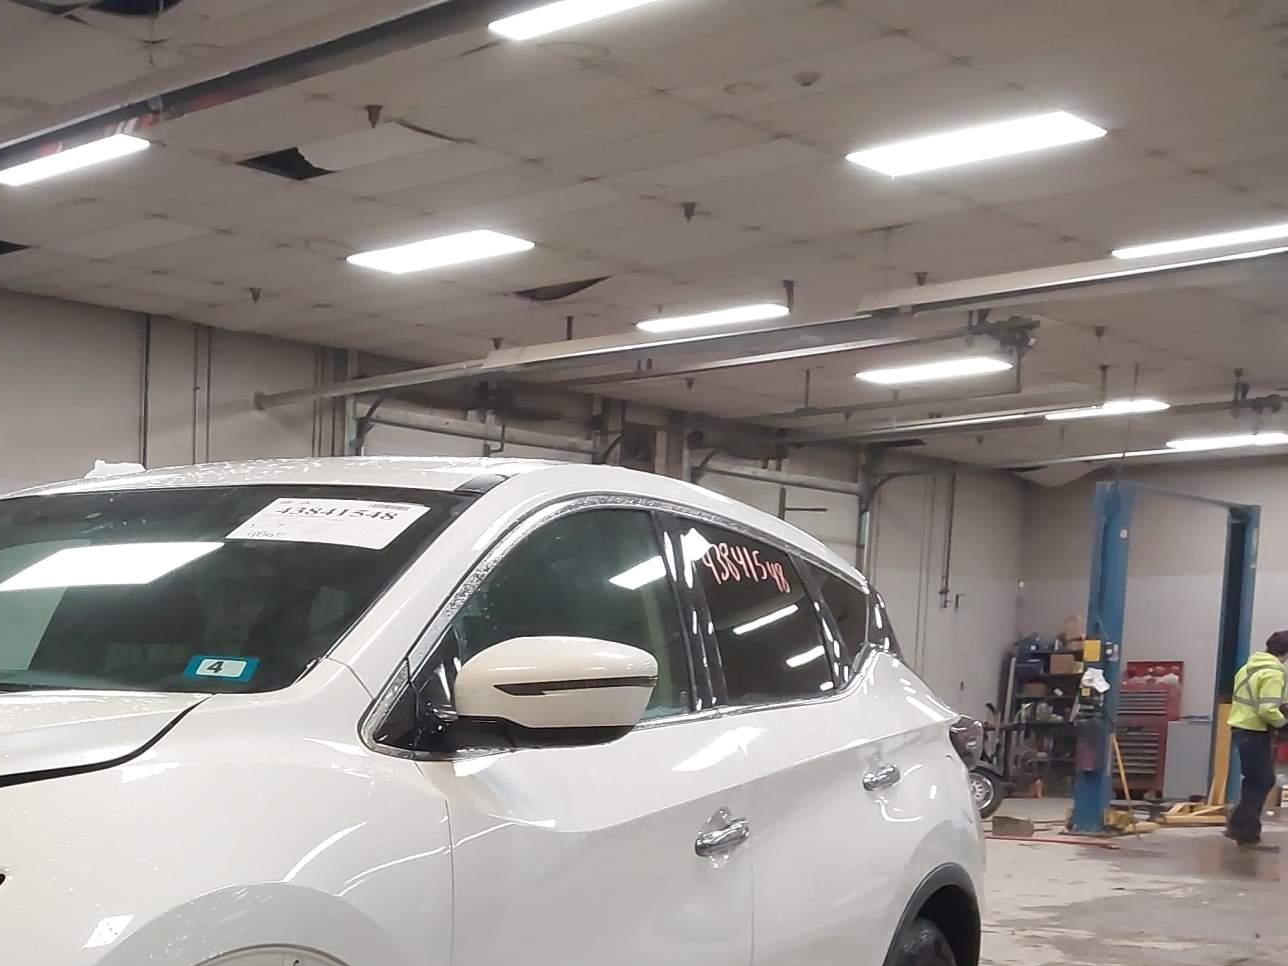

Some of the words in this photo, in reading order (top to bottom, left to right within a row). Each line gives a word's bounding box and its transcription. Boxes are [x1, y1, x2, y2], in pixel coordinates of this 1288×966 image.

[276, 506, 398, 521] 43841548
[703, 543, 790, 593] 43841548
[206, 661, 225, 673] 4
